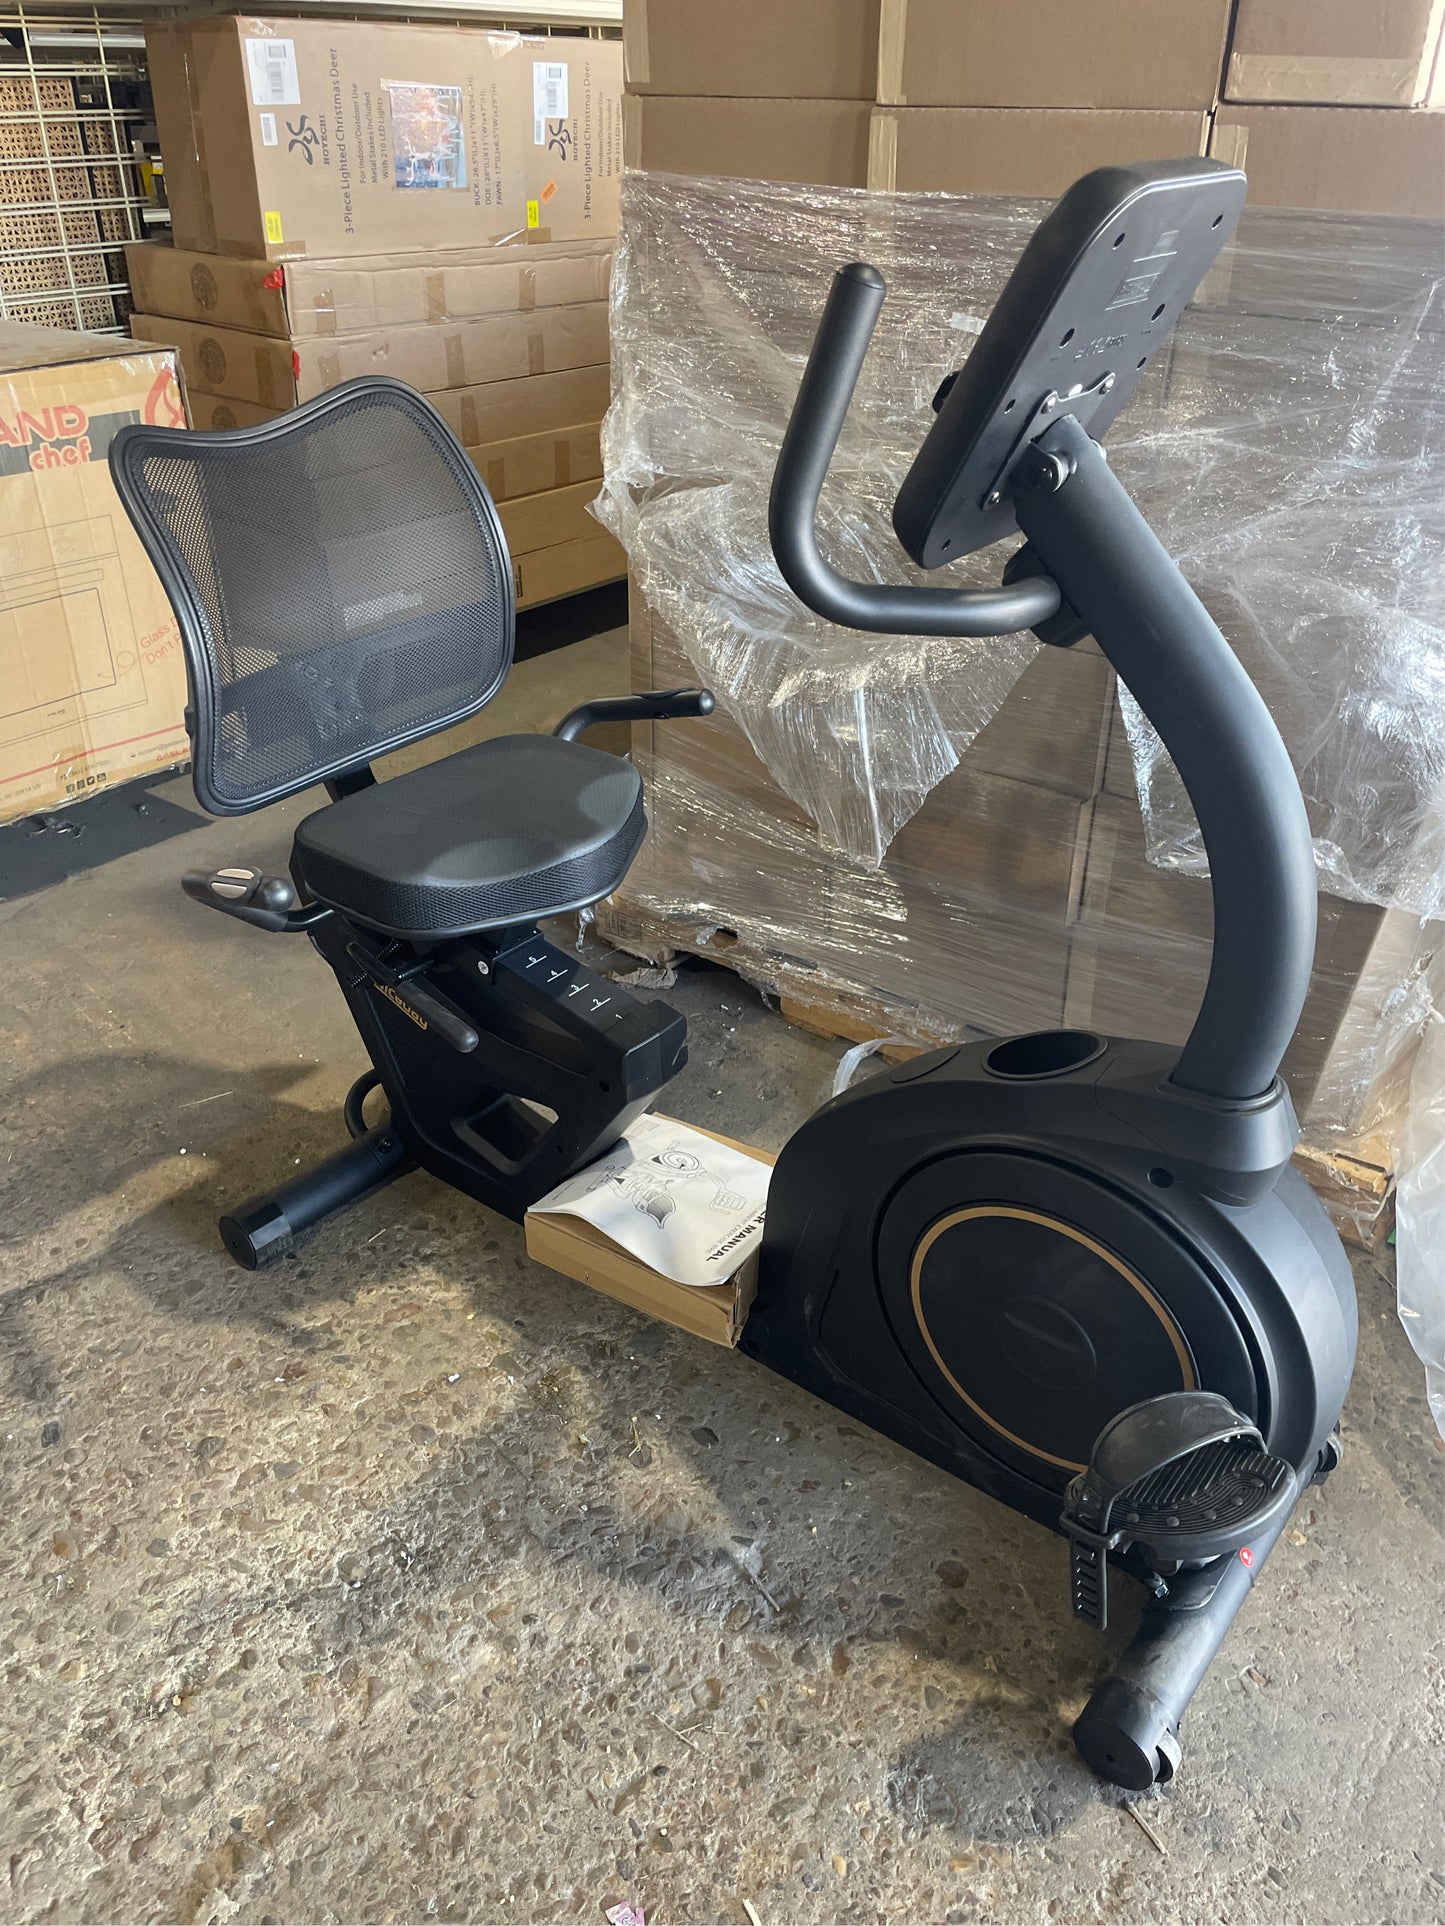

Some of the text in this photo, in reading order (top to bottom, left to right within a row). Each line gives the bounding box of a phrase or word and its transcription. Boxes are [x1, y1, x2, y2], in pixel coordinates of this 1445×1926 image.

[376, 97, 386, 124] Lights
[319, 114, 331, 165] HOYECHI
[328, 48, 355, 234] 3-Piece Lighted Christmas Deer
[350, 83, 367, 184] For Indoor/Outdoor Use
[363, 92, 379, 184] Metal Stakes Included
[378, 125, 387, 141] LED
[583, 61, 593, 220] 3-Piece Lighted Christmas Deer
[381, 160, 390, 179] With
[31, 437, 91, 470] chef
[140, 624, 171, 648] Glass
[145, 640, 175, 665] Don't
[706, 1224, 758, 1262] MANUAL
